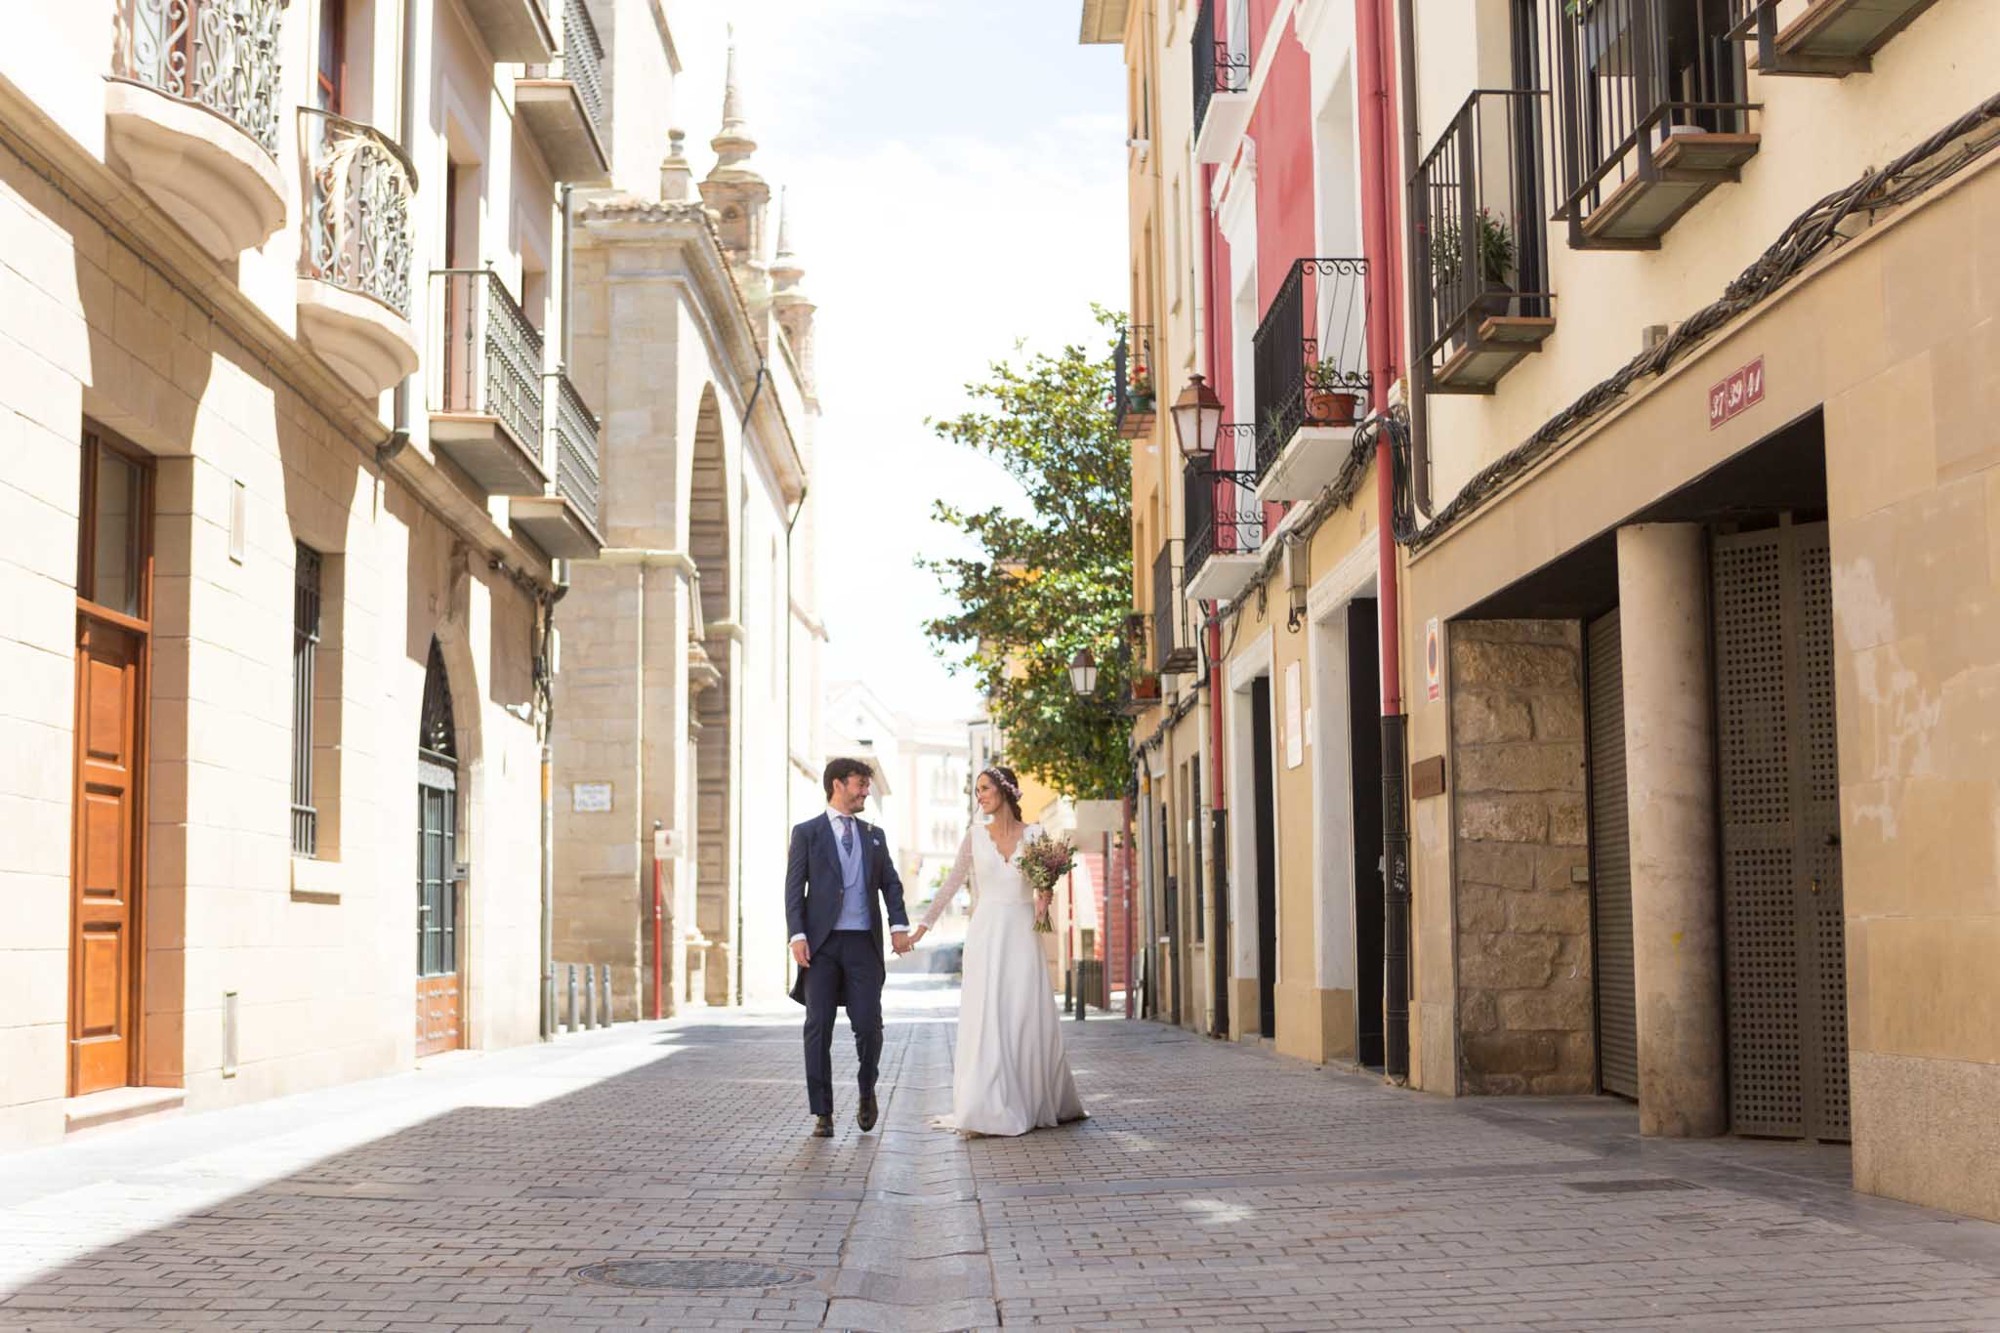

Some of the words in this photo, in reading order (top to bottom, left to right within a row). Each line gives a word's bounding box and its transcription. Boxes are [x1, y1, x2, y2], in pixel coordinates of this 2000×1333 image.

[1711, 391, 1724, 418] 37
[1728, 379, 1743, 407] 39
[1747, 368, 1760, 398] 41
